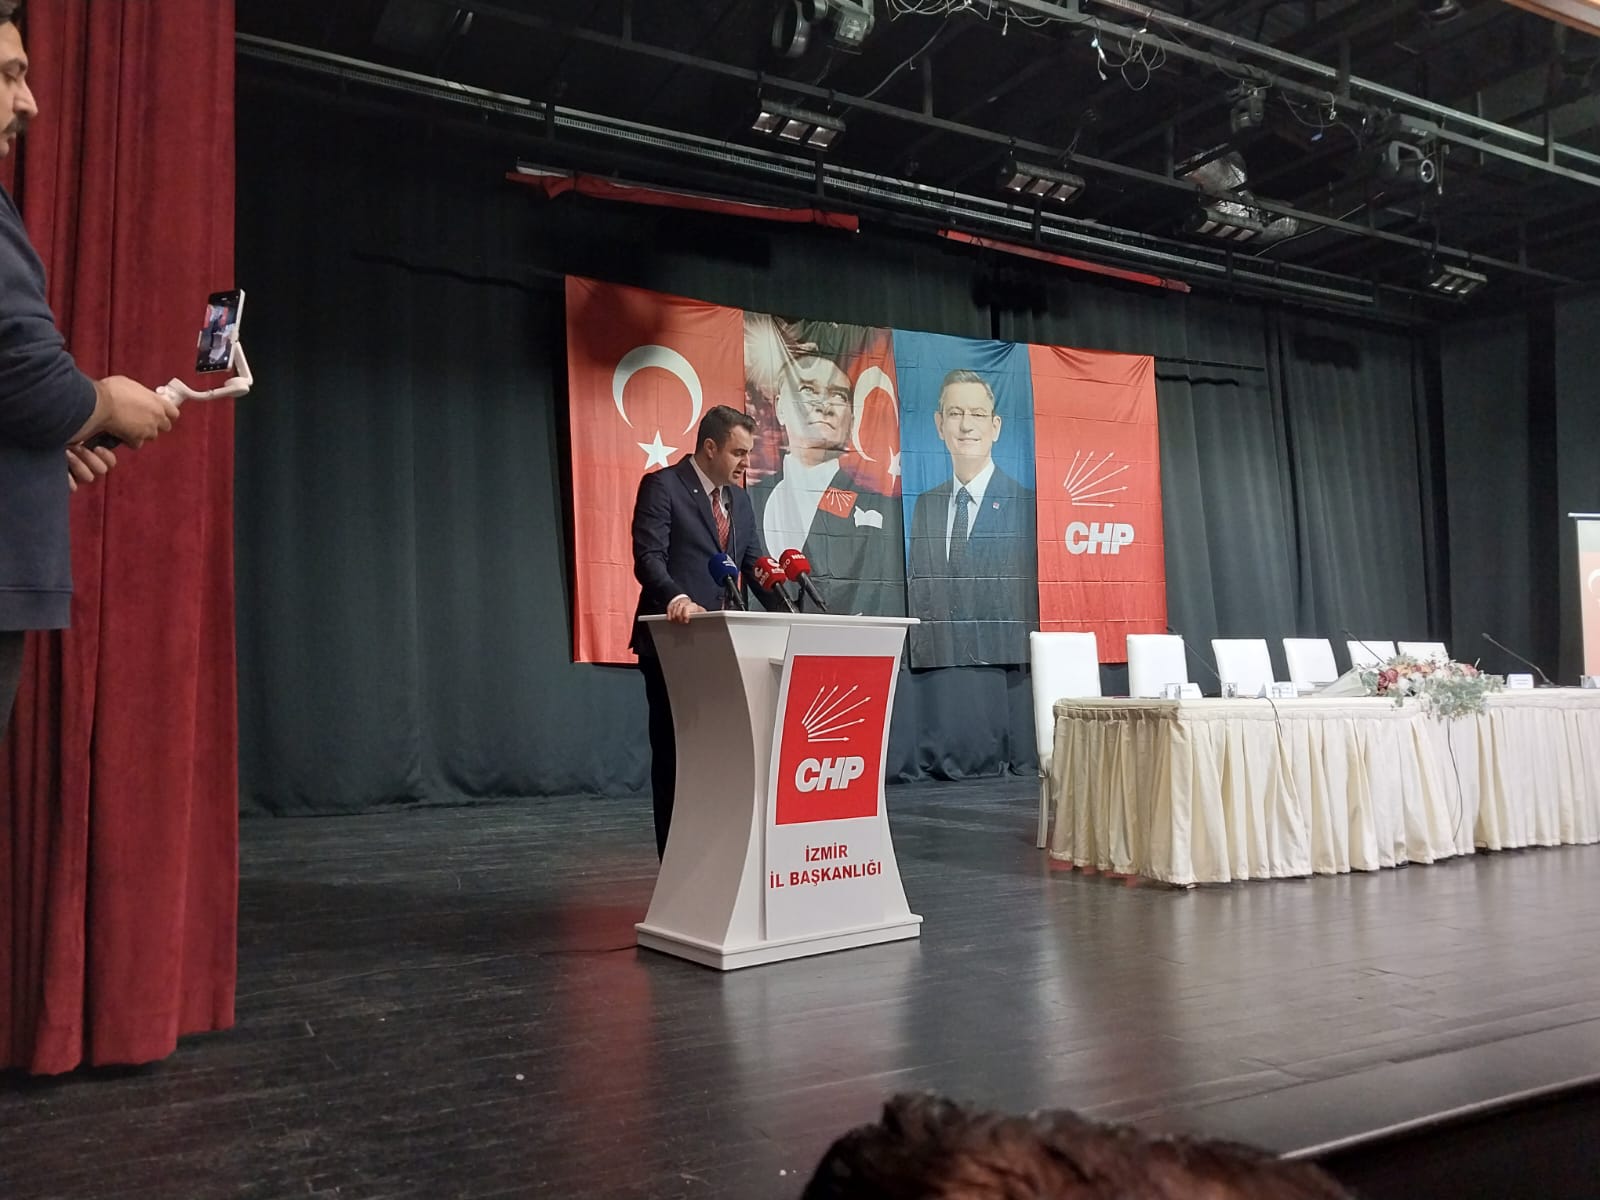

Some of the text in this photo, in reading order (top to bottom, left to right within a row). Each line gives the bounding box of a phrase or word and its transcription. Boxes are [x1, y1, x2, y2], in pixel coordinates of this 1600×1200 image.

[1065, 521, 1135, 555] CHP
[795, 756, 865, 793] CHP
[805, 842, 848, 862] İZMİR
[770, 859, 882, 889] İL BAŞKANLIĞI
